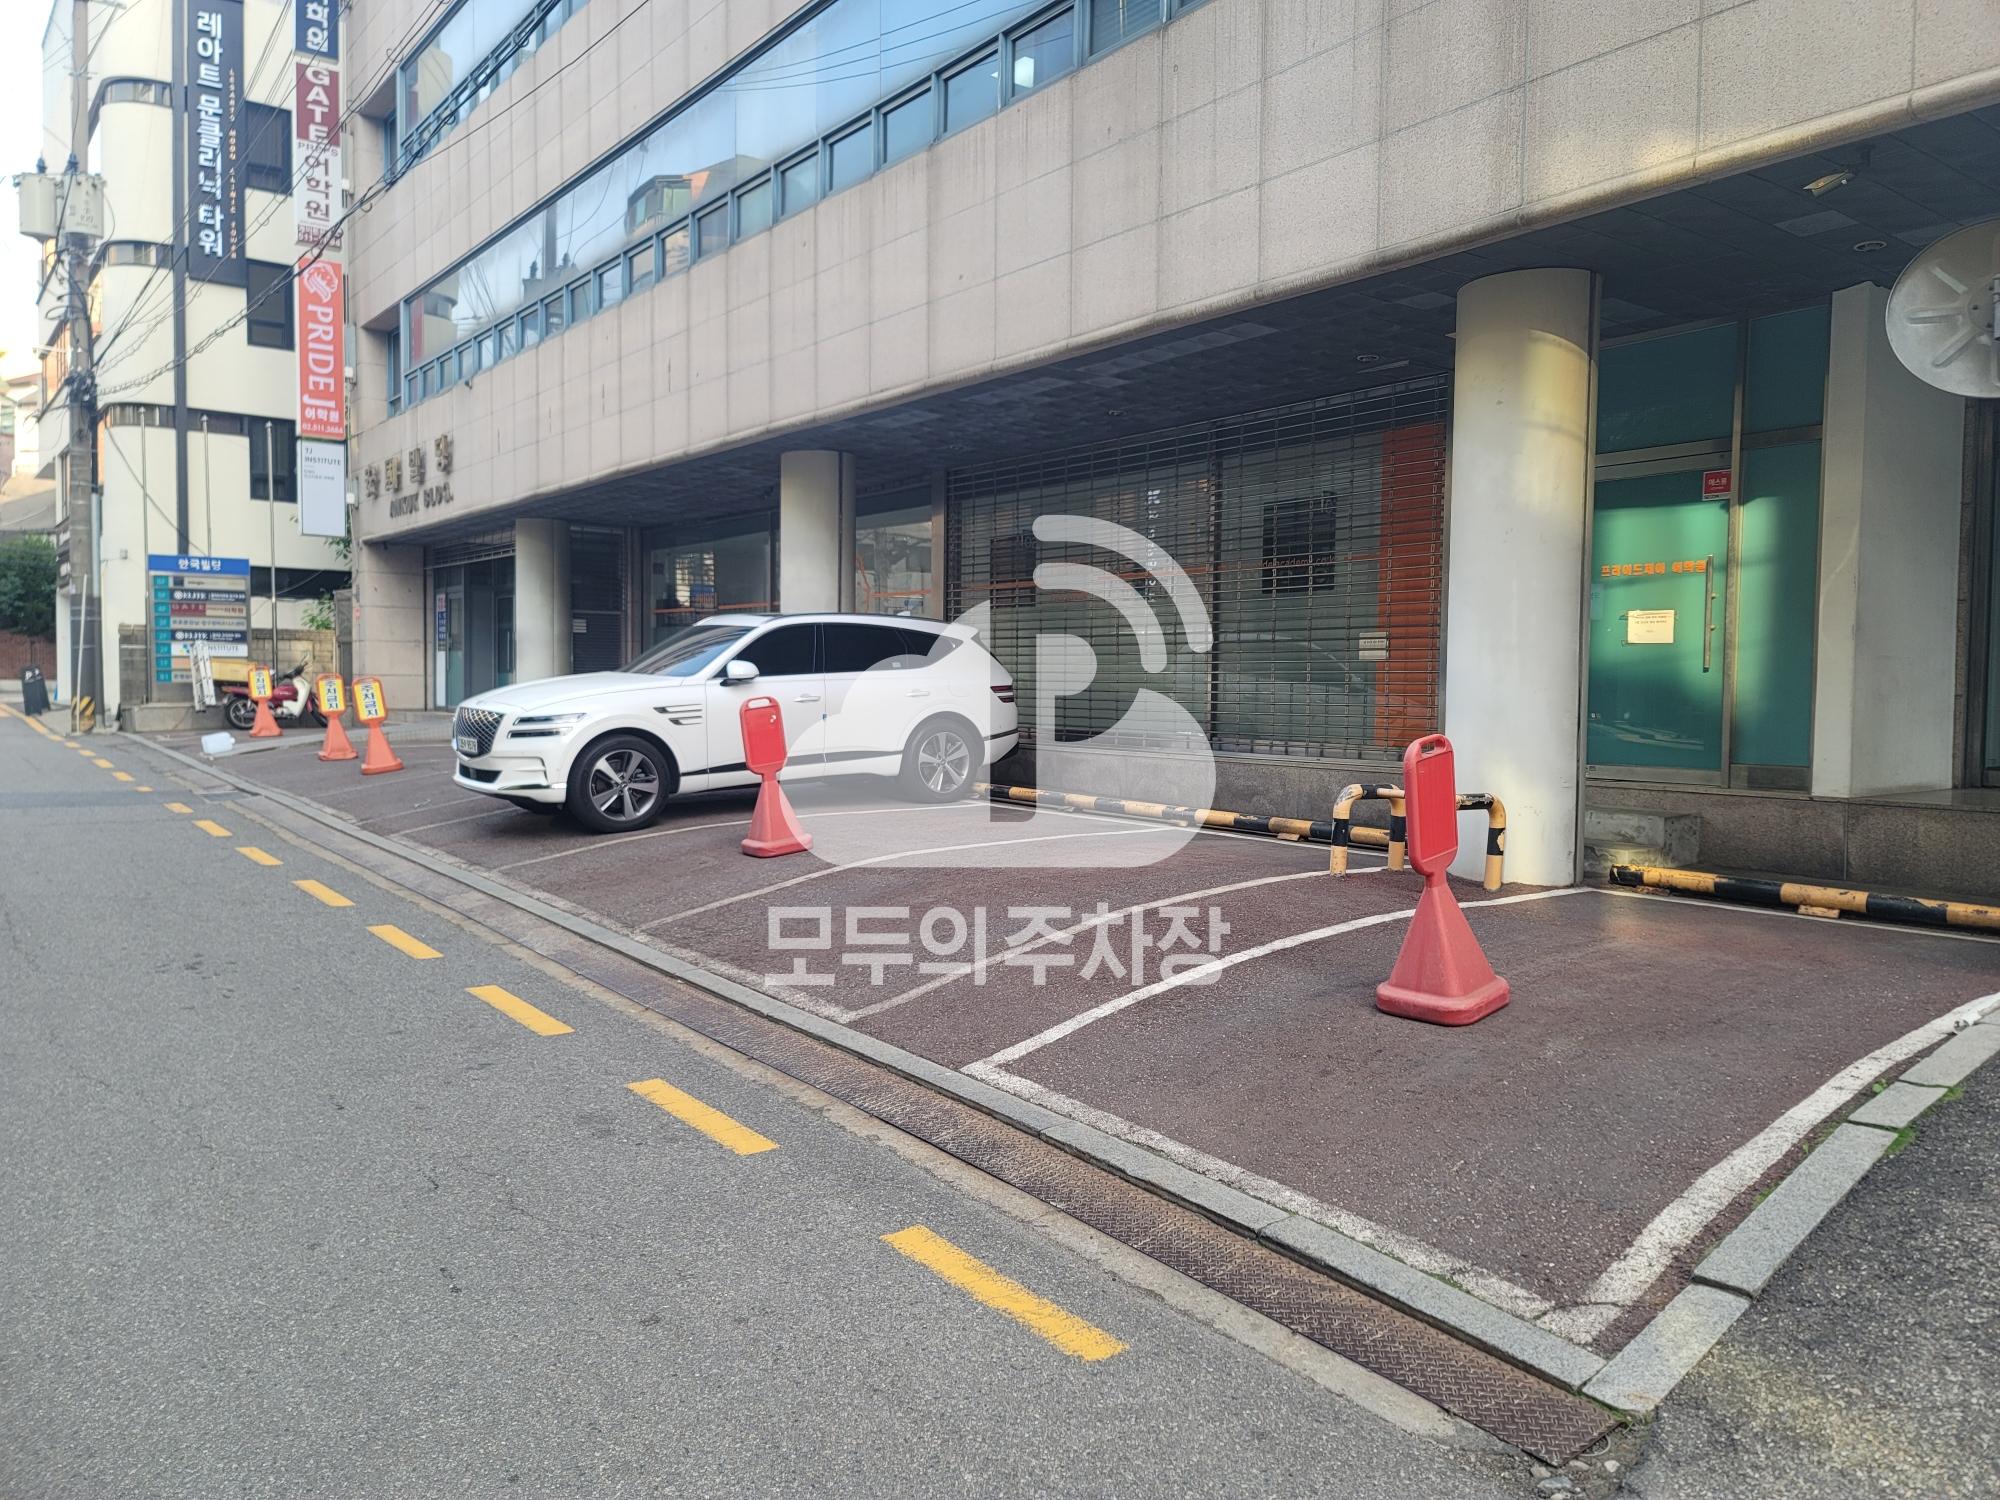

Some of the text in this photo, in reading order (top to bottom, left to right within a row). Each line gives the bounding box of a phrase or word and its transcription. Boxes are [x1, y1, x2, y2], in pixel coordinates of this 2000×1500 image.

[304, 0, 329, 53] 학원
[305, 66, 330, 144] GATE
[197, 10, 224, 258] 레아트 문클리닉 타워
[305, 155, 332, 222] 어학원
[307, 304, 335, 393] PRIDE
[304, 407, 340, 423] 어학원
[304, 456, 342, 467] INSTITUTE
[178, 558, 222, 571] 안국빌딩
[325, 680, 338, 709] 주차금지
[360, 685, 378, 716] 주차금지
